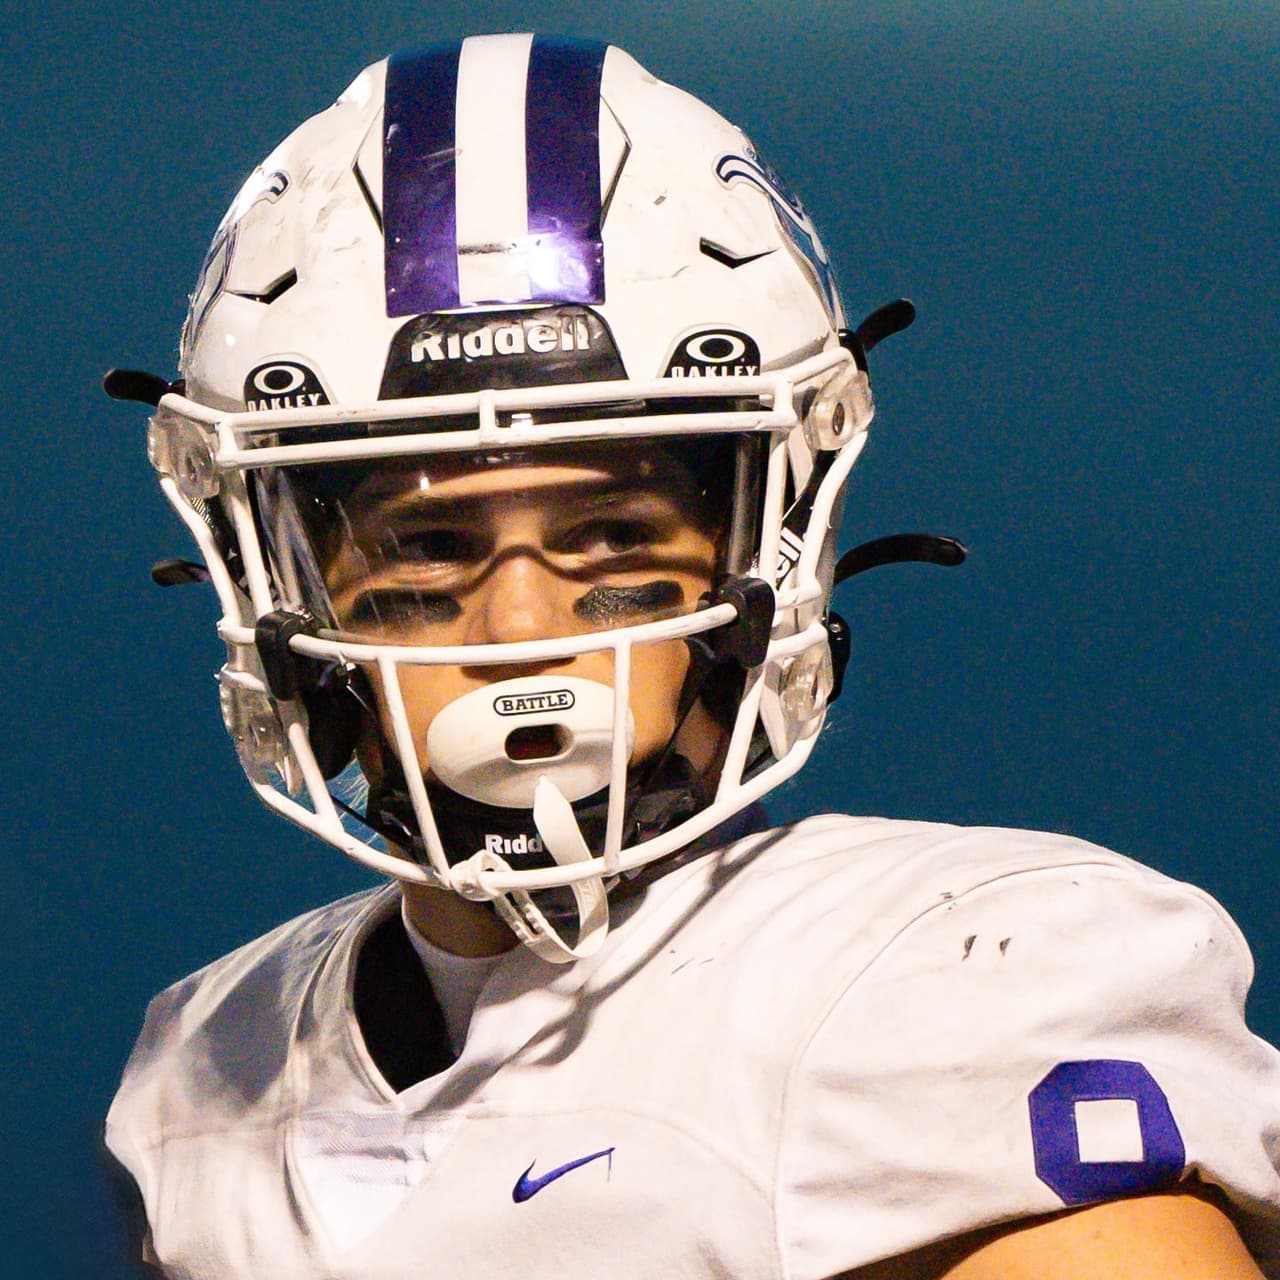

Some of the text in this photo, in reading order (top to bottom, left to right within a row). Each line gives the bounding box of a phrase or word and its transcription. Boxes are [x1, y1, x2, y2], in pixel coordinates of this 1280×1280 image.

[411, 312, 590, 363] Riddell
[671, 365, 758, 378] OAKLEY
[247, 393, 322, 412] OAKLEY
[502, 694, 569, 712] BATTLE
[485, 833, 544, 854] Ridd
